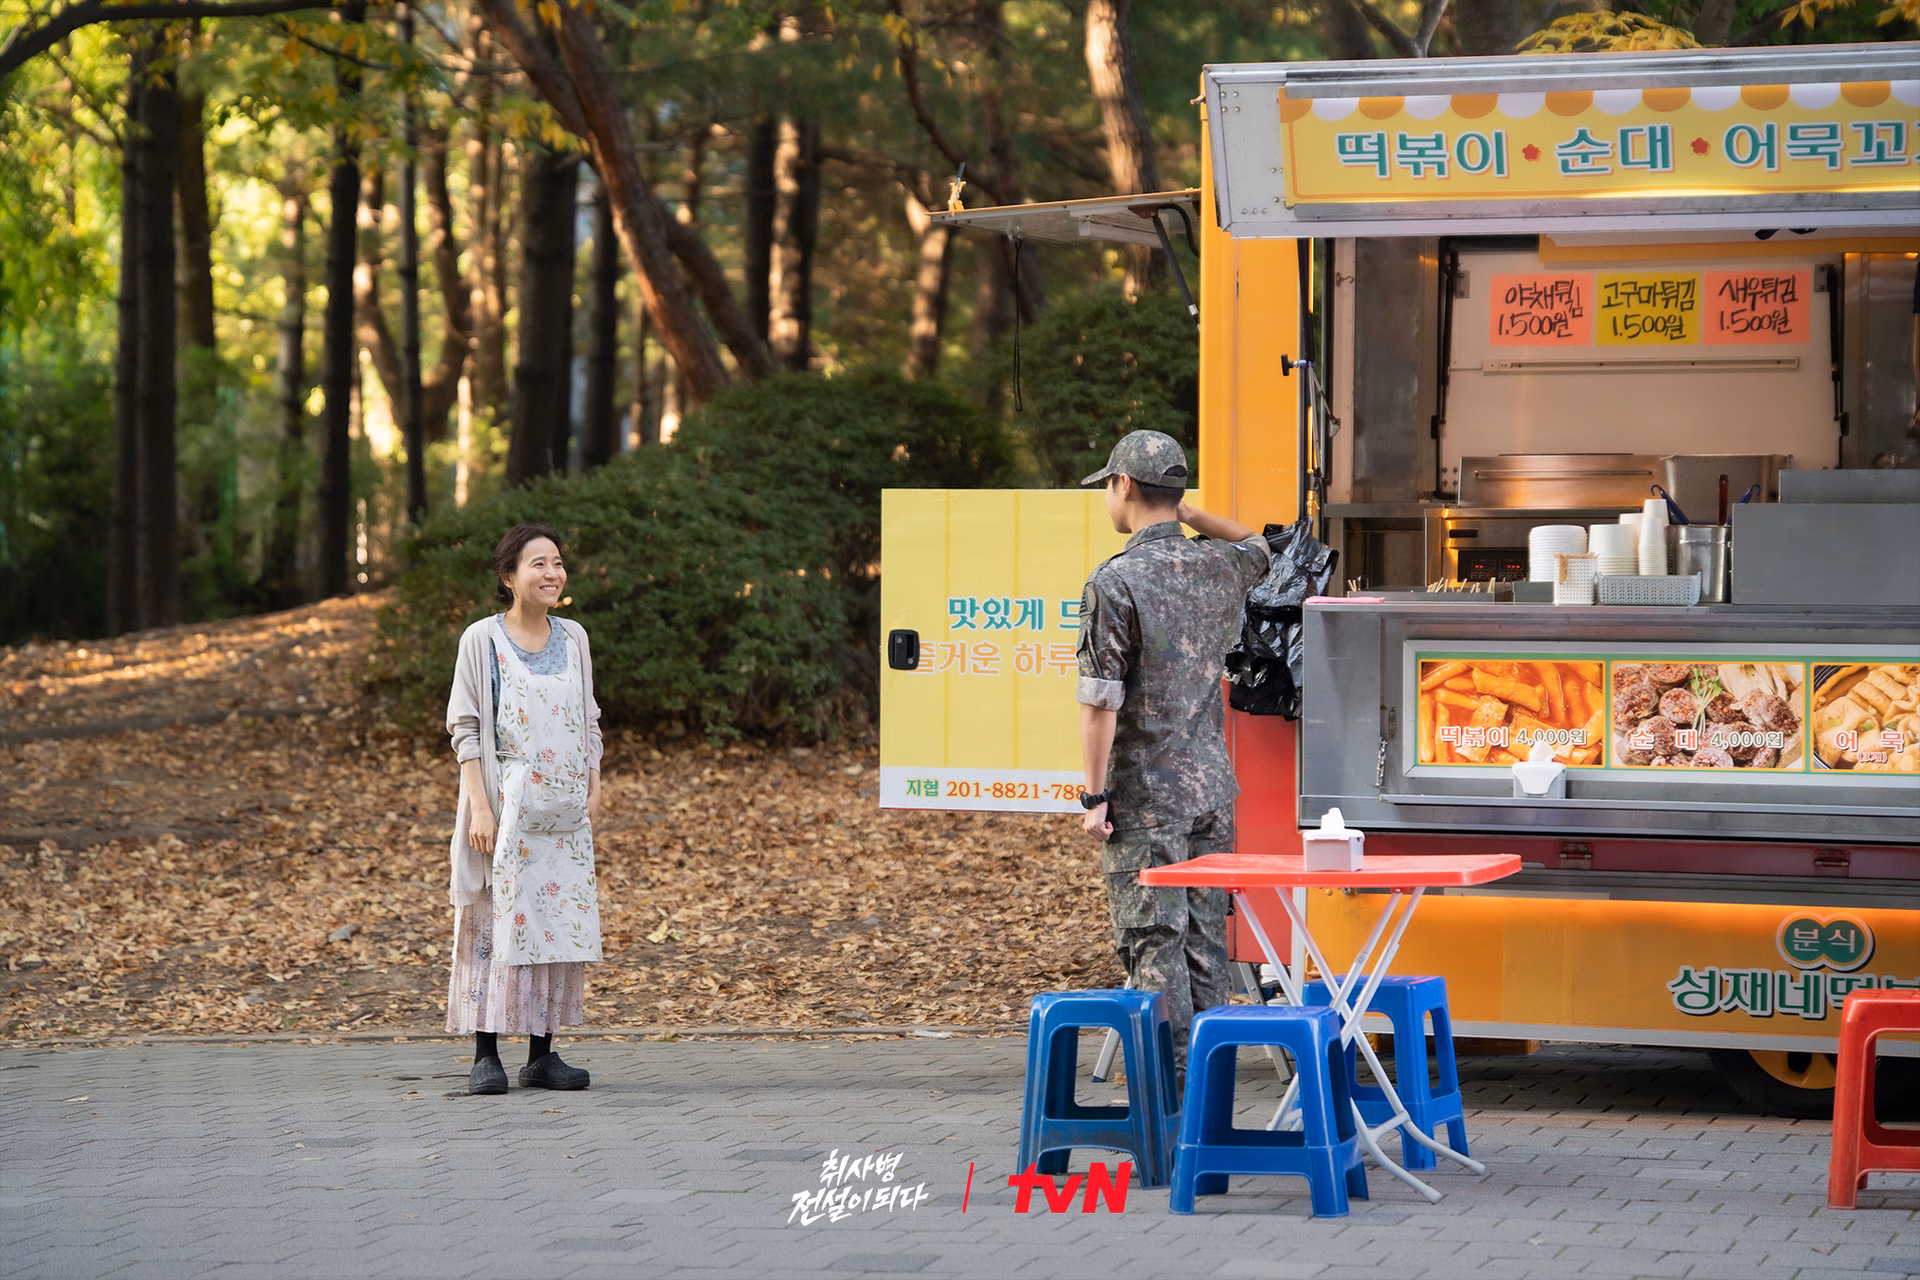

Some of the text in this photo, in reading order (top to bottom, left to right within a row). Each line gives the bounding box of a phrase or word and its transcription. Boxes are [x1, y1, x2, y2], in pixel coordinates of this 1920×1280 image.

[1336, 120, 1920, 179] 떡볶이 순대 어묵꼬
[1505, 279, 1583, 318] 야채튀김
[1602, 278, 1697, 312] 고구마튀김
[1718, 274, 1799, 311] 새우튀김
[1498, 310, 1573, 338] 1.500원
[1612, 313, 1687, 340] 1.500원
[1719, 307, 1793, 334] 1.500원
[948, 596, 1045, 631] 맛있게
[1014, 642, 1078, 677] 하루
[1440, 726, 1588, 747] 떡볶이 4,000원
[1710, 731, 1785, 749] 4,000원
[906, 779, 939, 797] 지협
[1793, 928, 1856, 953] 분식
